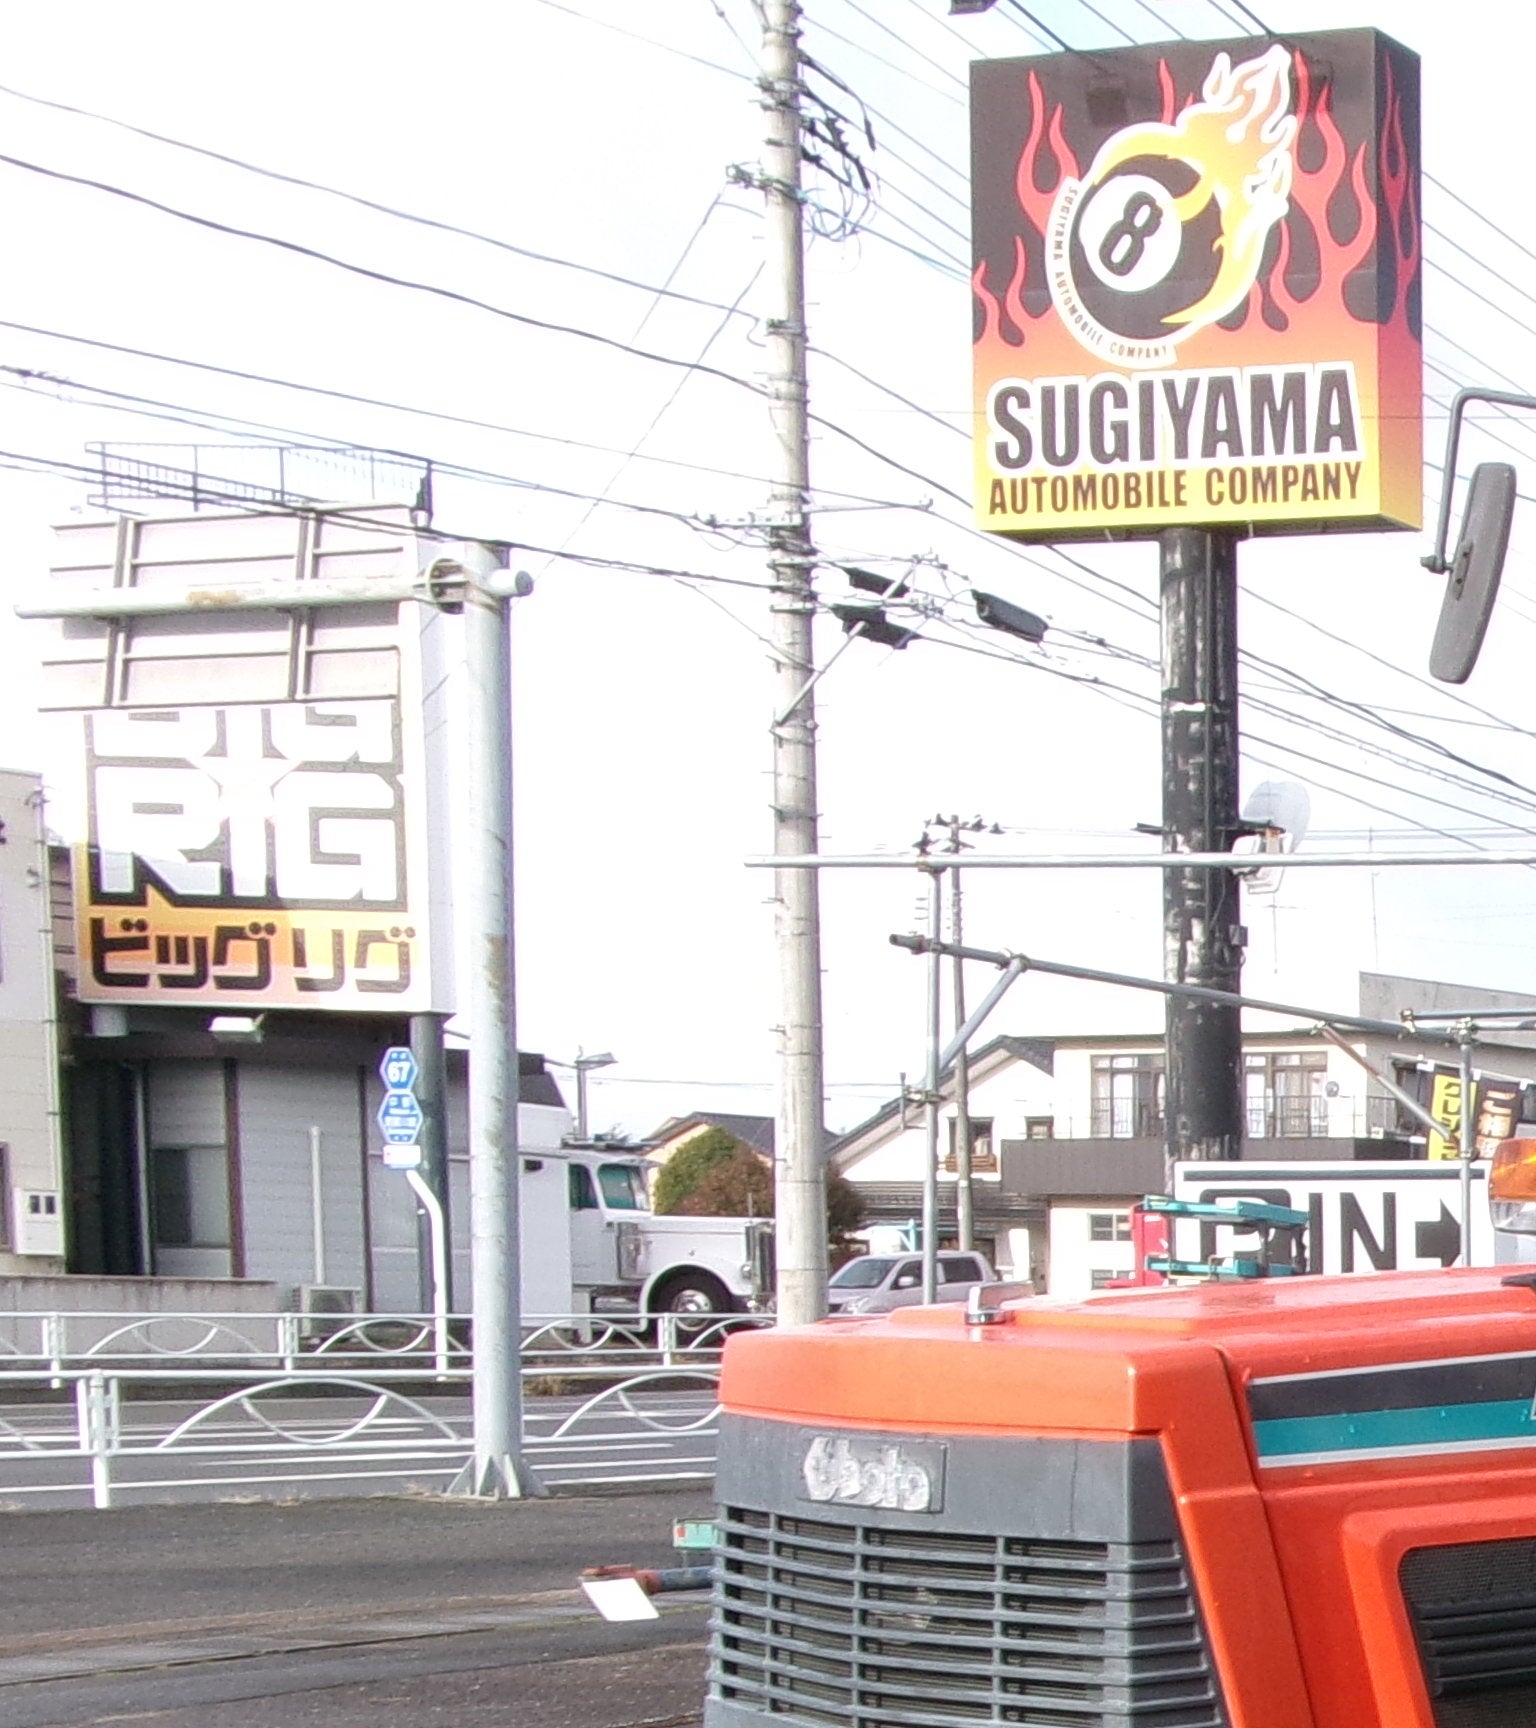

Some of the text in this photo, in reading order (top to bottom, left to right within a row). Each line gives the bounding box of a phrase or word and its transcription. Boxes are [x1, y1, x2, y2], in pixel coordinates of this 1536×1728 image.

[1099, 191, 1163, 276] 8
[994, 369, 1358, 469] SUGIYAMA
[989, 462, 1362, 515] AUTOMOBILE COMPANY
[387, 1061, 411, 1083] 67
[1308, 1192, 1396, 1275] IN
